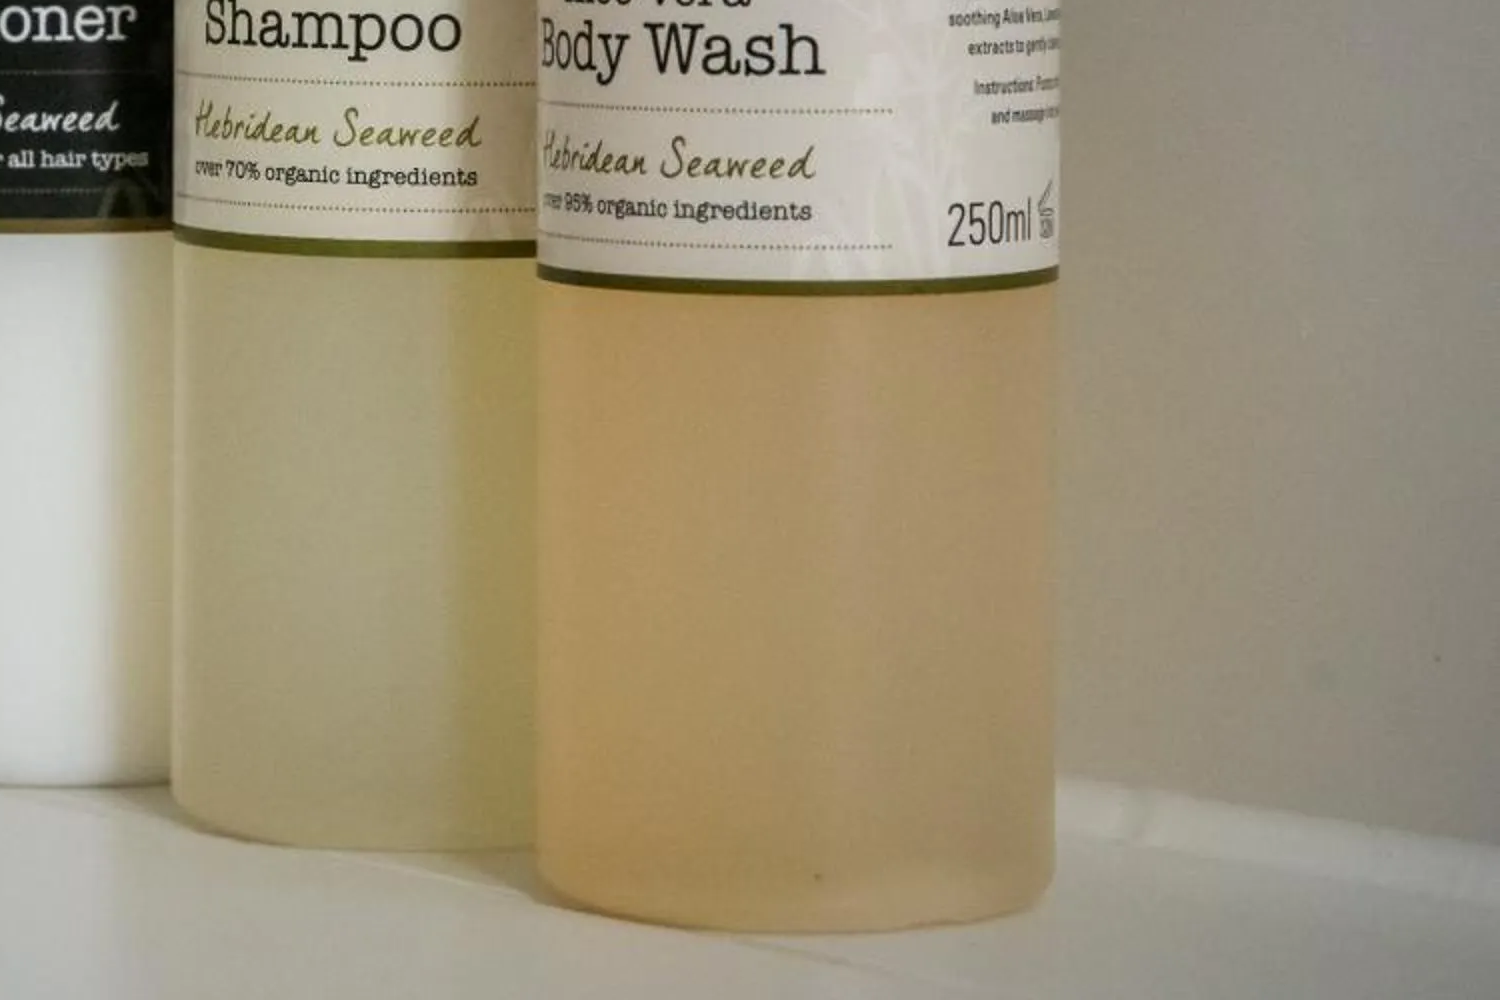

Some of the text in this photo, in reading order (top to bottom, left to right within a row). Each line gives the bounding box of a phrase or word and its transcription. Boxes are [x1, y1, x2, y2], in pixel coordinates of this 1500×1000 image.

[948, 10, 1000, 29] soothing
[541, 17, 826, 86] Body Wash
[967, 40, 1014, 56] extracts
[195, 99, 483, 148] Hebridean Seaweed
[7, 150, 34, 168] all
[40, 150, 86, 169] hair
[91, 149, 149, 172] types
[543, 130, 816, 179] Hebridean Seaweed
[225, 160, 261, 181] 70%
[265, 165, 340, 186] organic
[346, 167, 478, 189] ingredients
[564, 192, 593, 214] 95%
[597, 198, 668, 220] organic
[672, 200, 812, 223] ingredients
[947, 196, 1031, 247] 250ml
